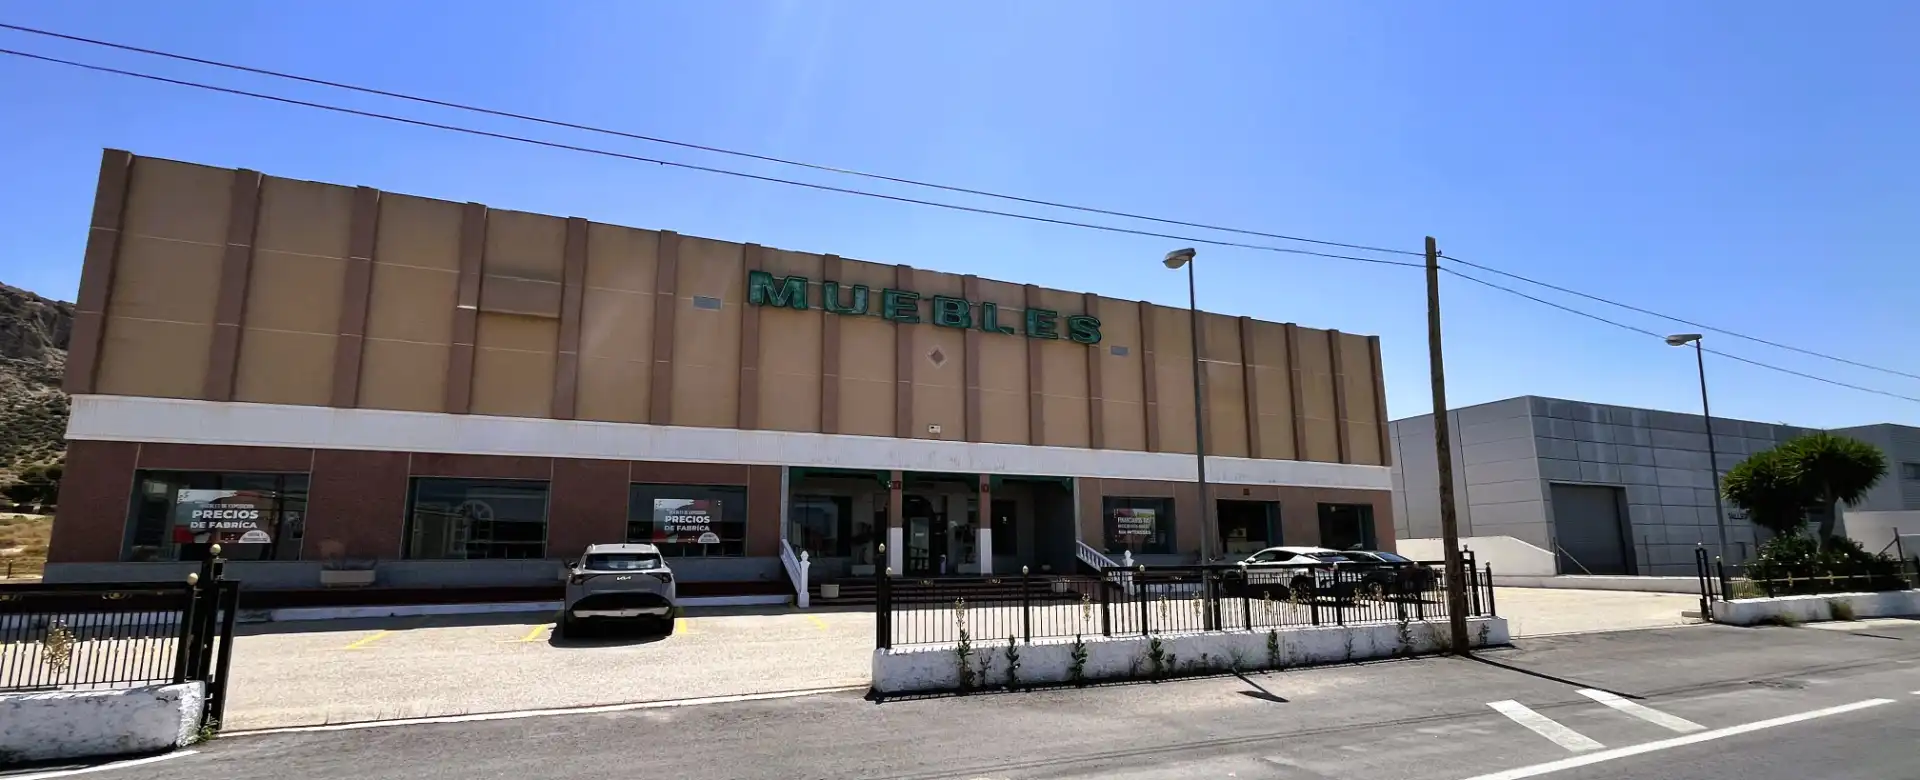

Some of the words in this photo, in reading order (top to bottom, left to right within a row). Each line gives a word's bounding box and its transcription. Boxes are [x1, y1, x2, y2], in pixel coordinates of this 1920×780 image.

[749, 269, 1102, 344] MUEBLES
[191, 509, 259, 519] PRECIOS
[665, 515, 711, 524] PRECIOS
[190, 521, 206, 529] DE
